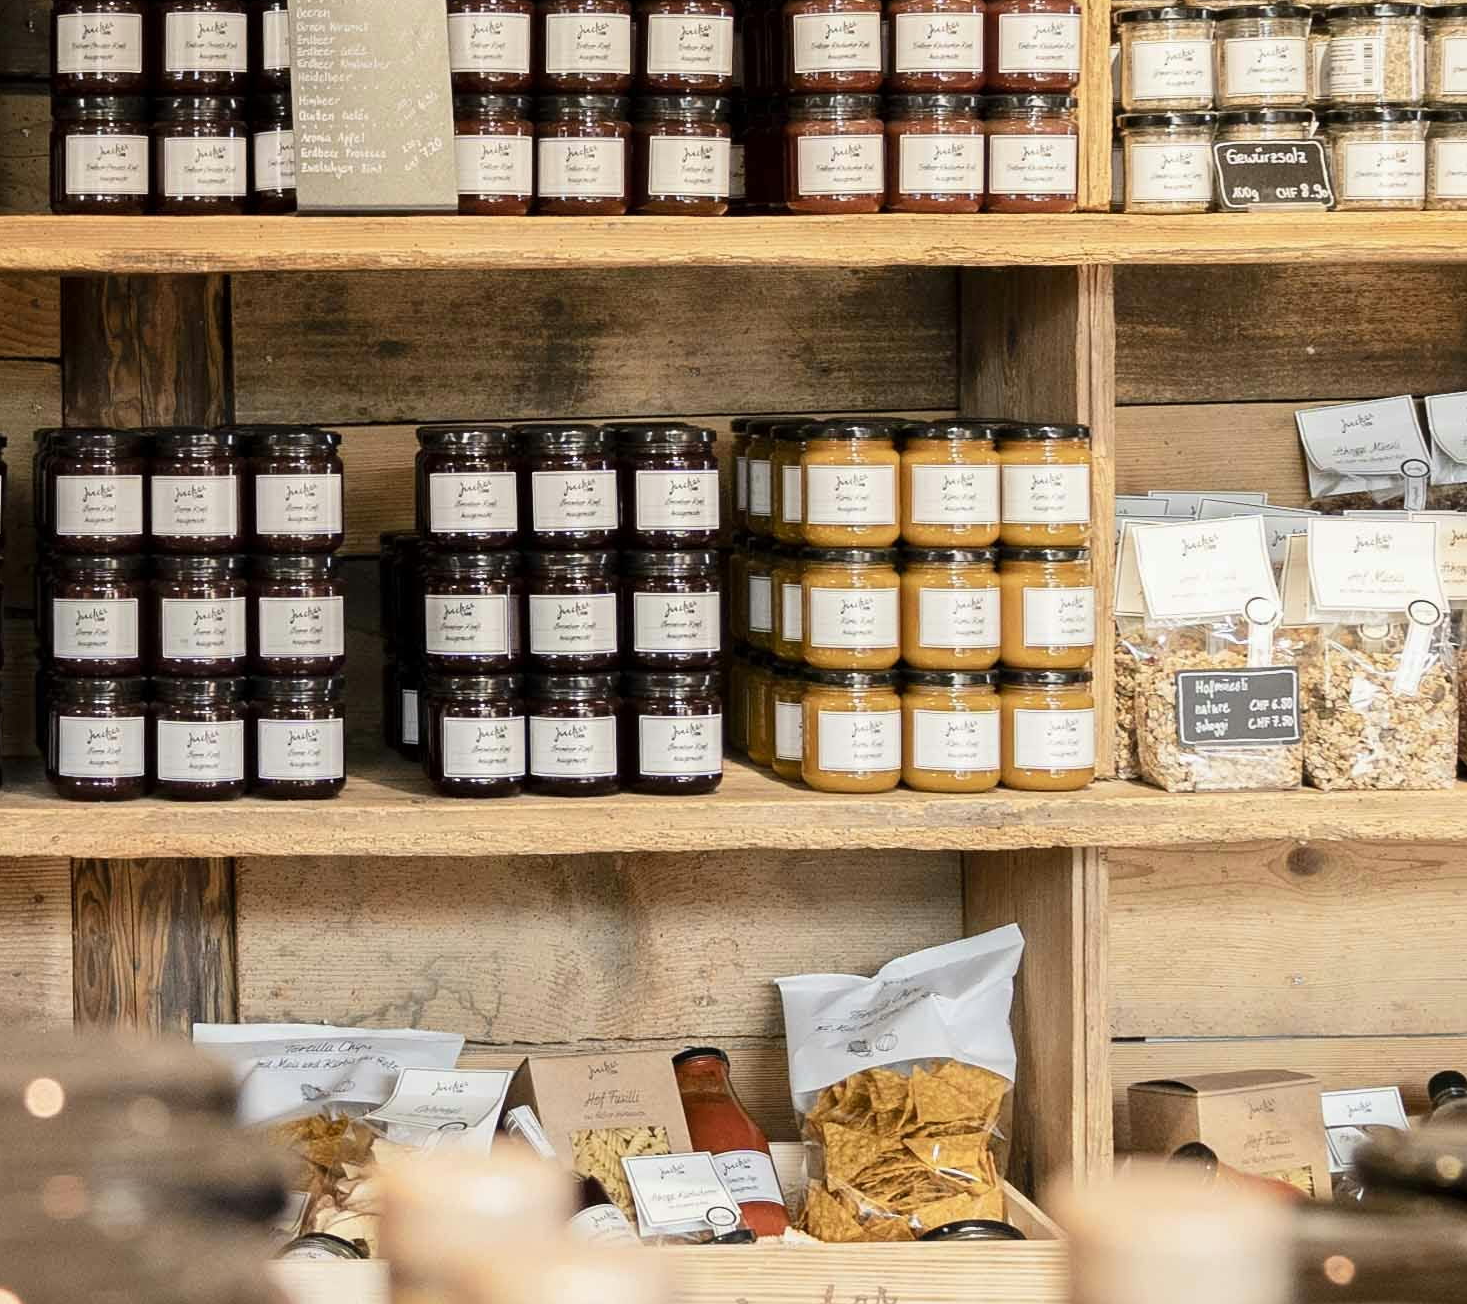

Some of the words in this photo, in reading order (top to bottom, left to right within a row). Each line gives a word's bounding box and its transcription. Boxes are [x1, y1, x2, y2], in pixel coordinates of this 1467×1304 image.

[1226, 146, 1308, 165] Gewürzsalz
[1232, 186, 1260, 202] 100g
[1275, 187, 1298, 199] CHF
[1195, 700, 1231, 715] nature
[1249, 698, 1270, 711] CHF
[1248, 717, 1270, 729] CHF
[284, 1042, 334, 1055] Tortilla
[338, 1040, 372, 1053] Chips
[303, 1059, 319, 1069] und
[585, 1091, 606, 1108] Hof
[608, 1089, 642, 1104] Fusilli
